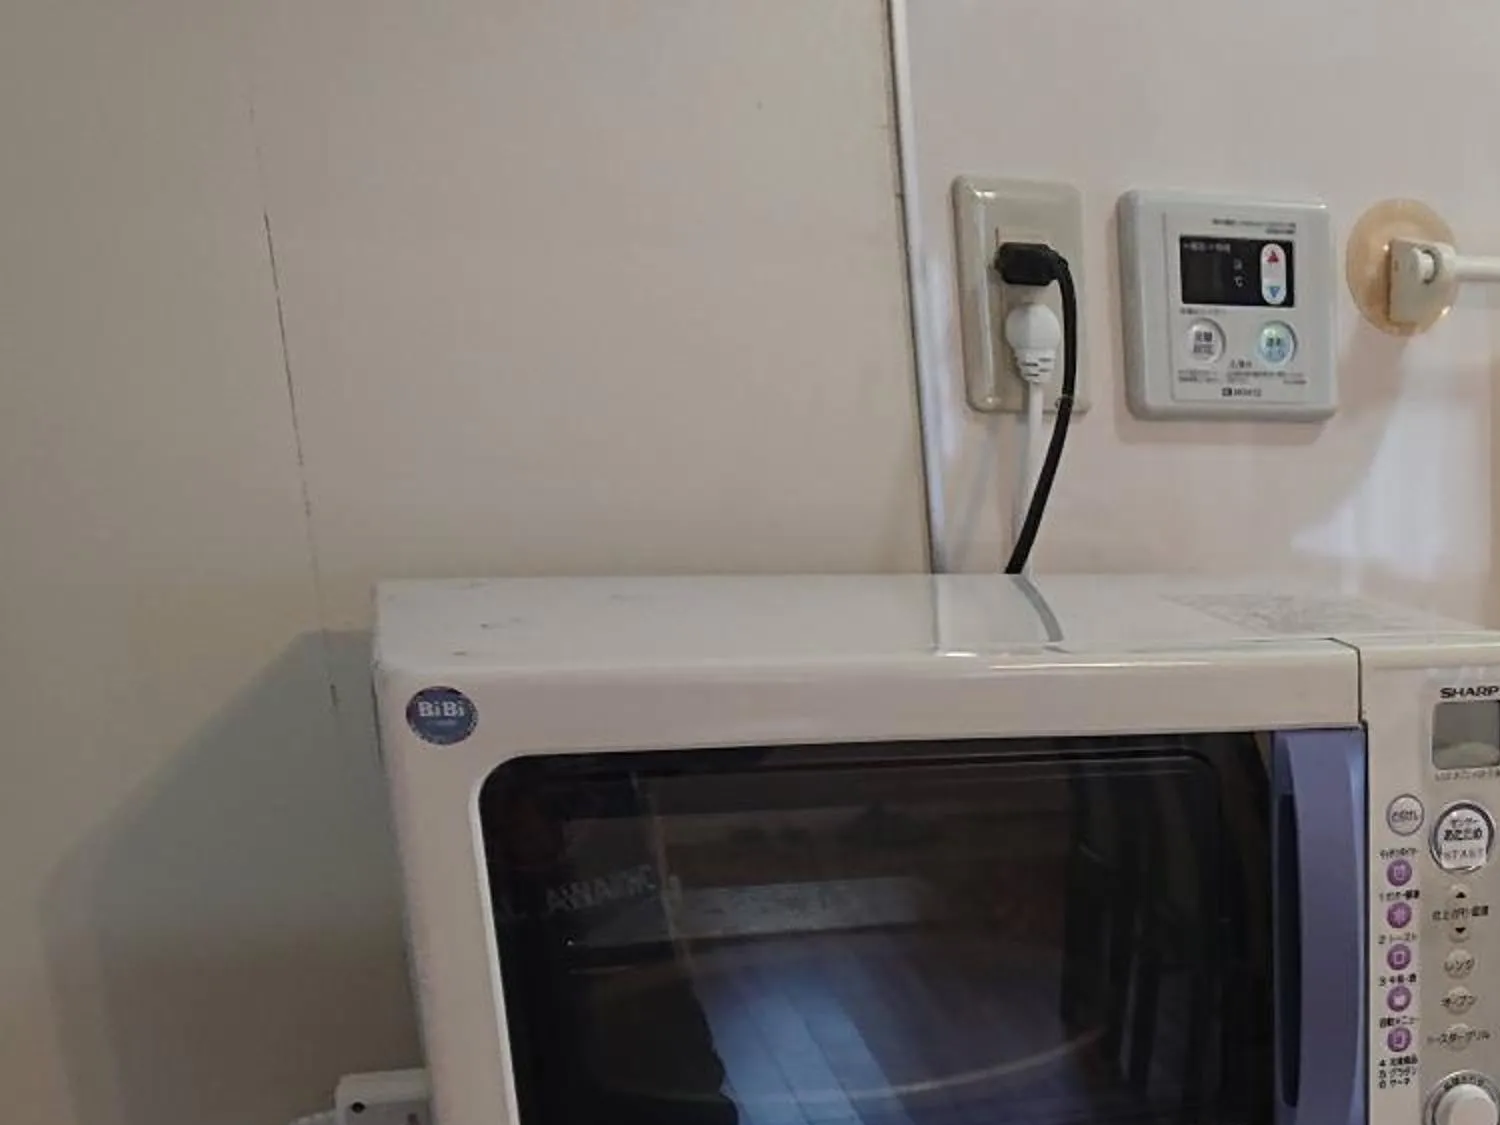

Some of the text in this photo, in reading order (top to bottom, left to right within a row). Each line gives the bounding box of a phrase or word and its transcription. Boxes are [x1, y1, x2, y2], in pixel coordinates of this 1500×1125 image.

[1440, 686, 1500, 699] SHARP
[418, 700, 465, 717] BiBi
[1444, 828, 1483, 842] あたため
[1444, 957, 1475, 972] レンジ
